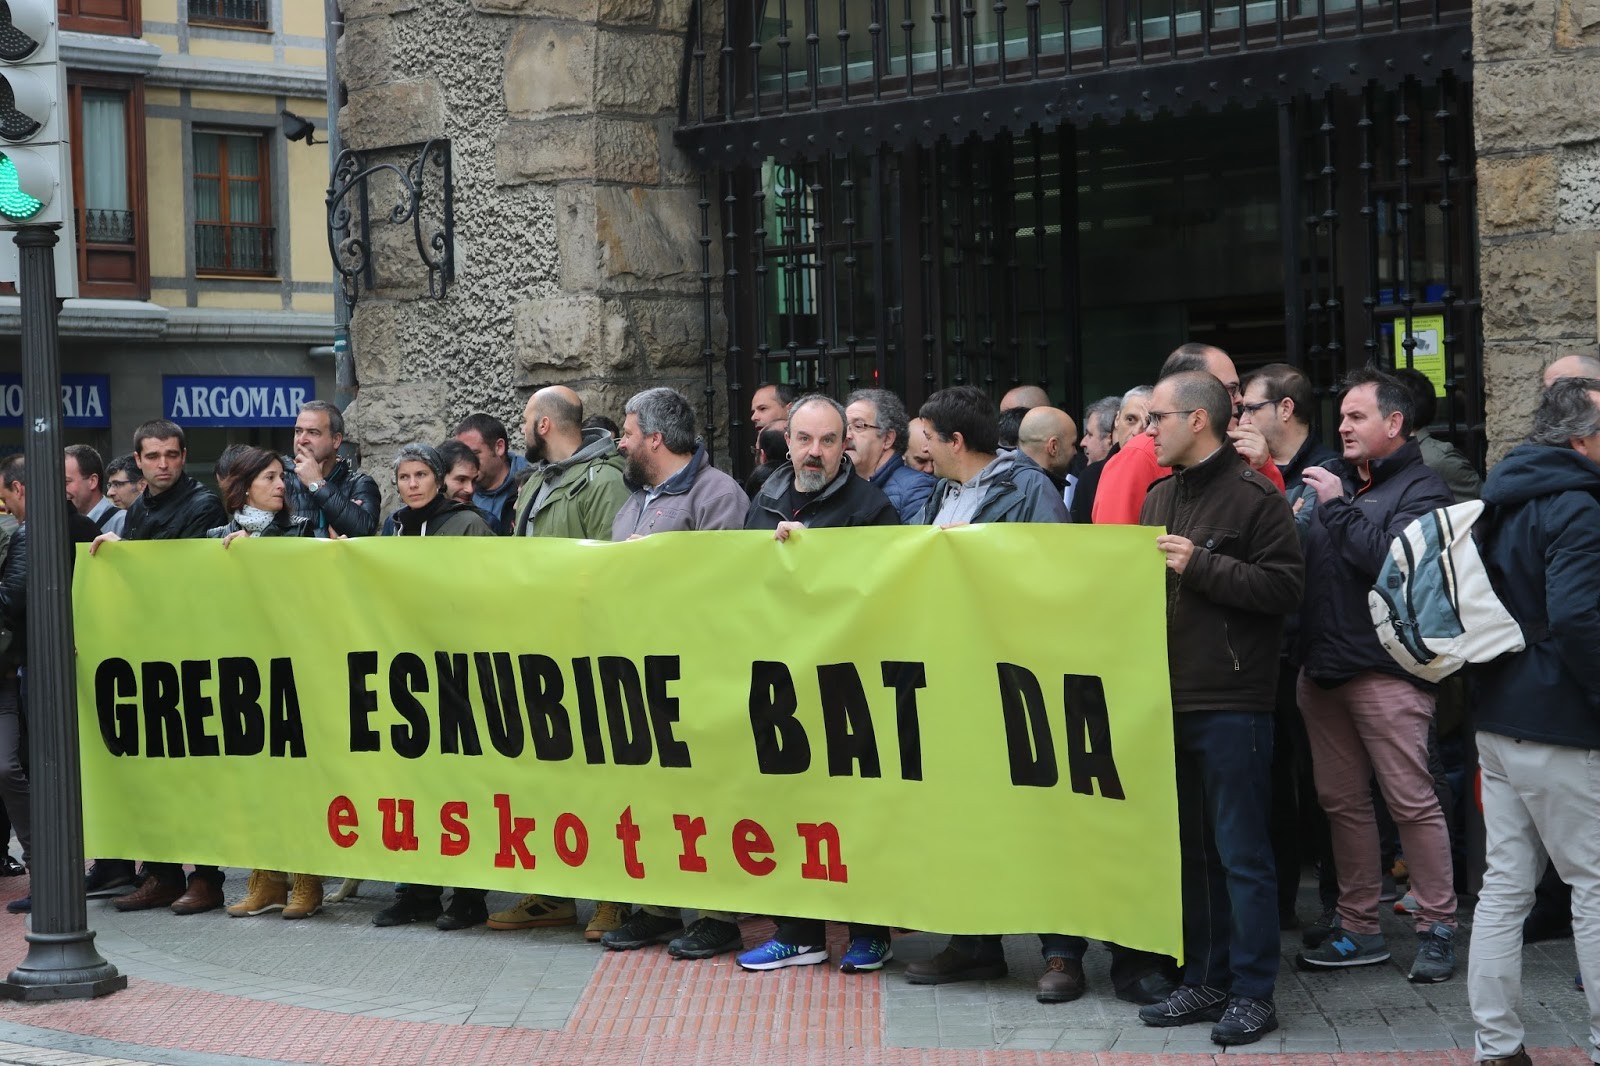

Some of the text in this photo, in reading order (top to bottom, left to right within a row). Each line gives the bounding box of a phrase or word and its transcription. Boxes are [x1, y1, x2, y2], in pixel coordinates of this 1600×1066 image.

[171, 386, 306, 418] ARGOMAR
[95, 650, 1126, 801] GREBA ESKUBIDE BAT DA
[328, 793, 848, 883] euskotren
